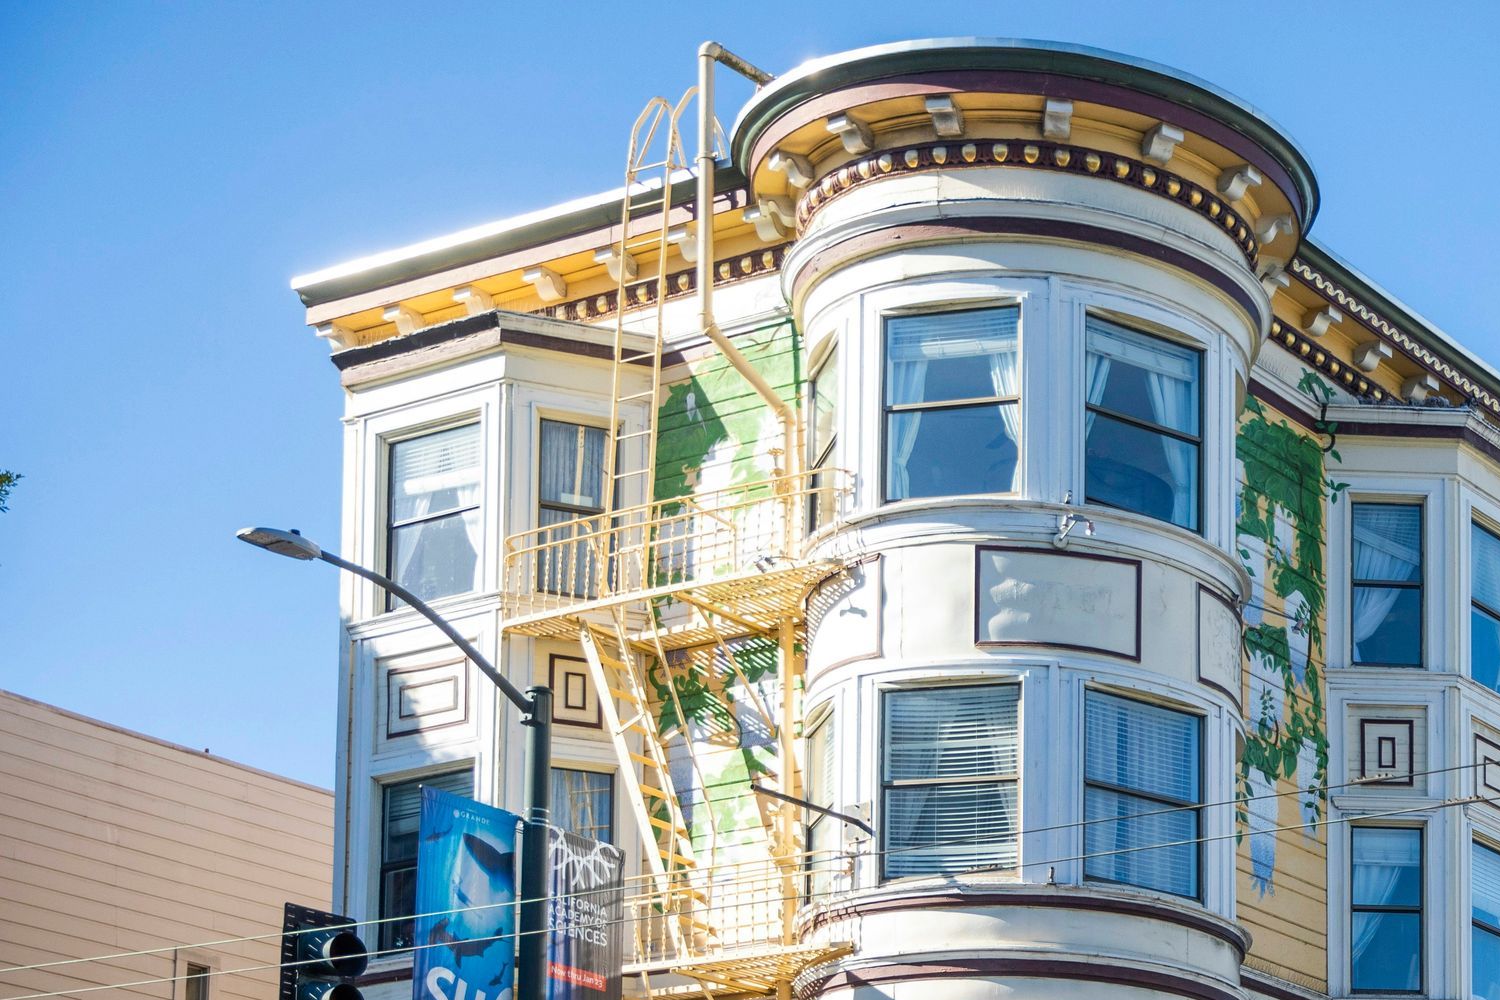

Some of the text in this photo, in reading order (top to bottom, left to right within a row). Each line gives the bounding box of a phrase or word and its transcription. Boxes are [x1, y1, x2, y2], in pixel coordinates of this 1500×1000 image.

[549, 904, 594, 926] ACADEMY
[550, 891, 608, 919] CALIFORNIA
[549, 917, 608, 947] SCIENCES
